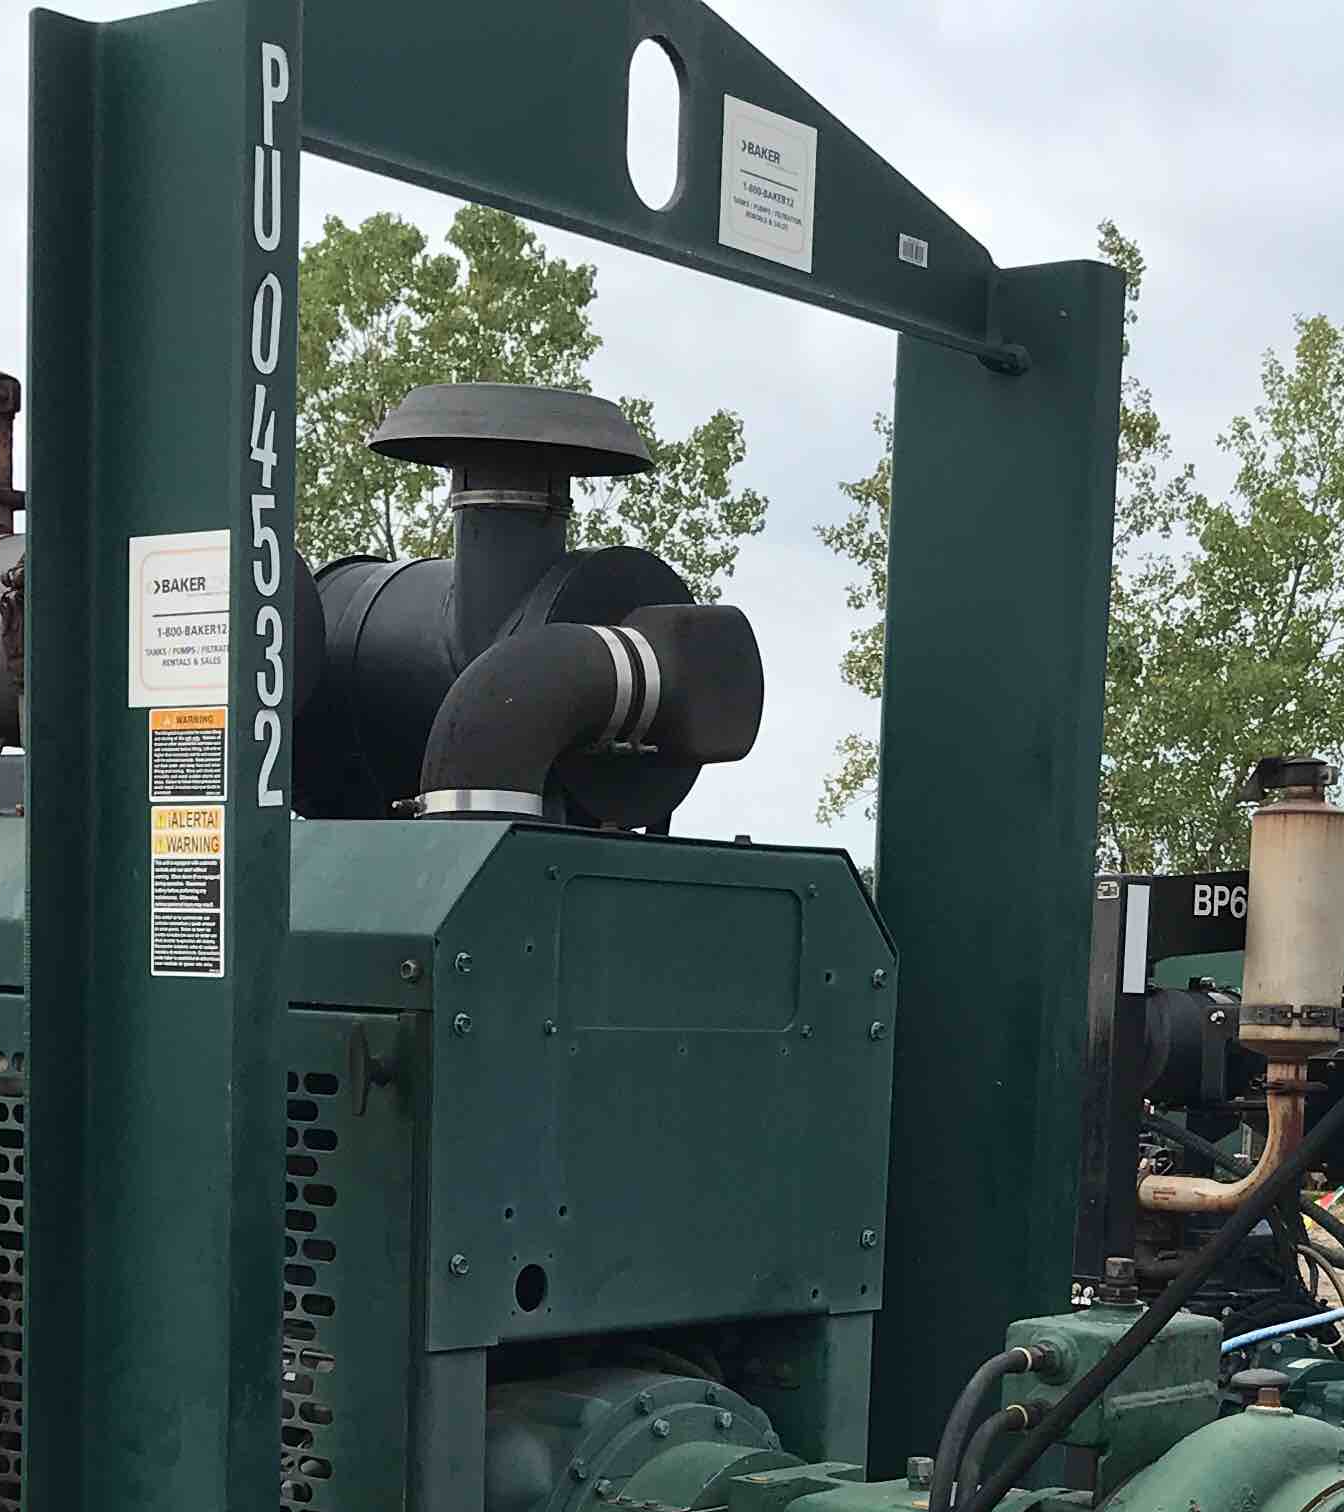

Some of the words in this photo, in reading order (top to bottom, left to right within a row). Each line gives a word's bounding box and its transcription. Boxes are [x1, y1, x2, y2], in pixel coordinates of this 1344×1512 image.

[748, 141, 781, 164] BAKER
[161, 576, 206, 593] BAKER
[157, 623, 227, 638] 1-800-BAKER12
[166, 836, 220, 853] WARNING
